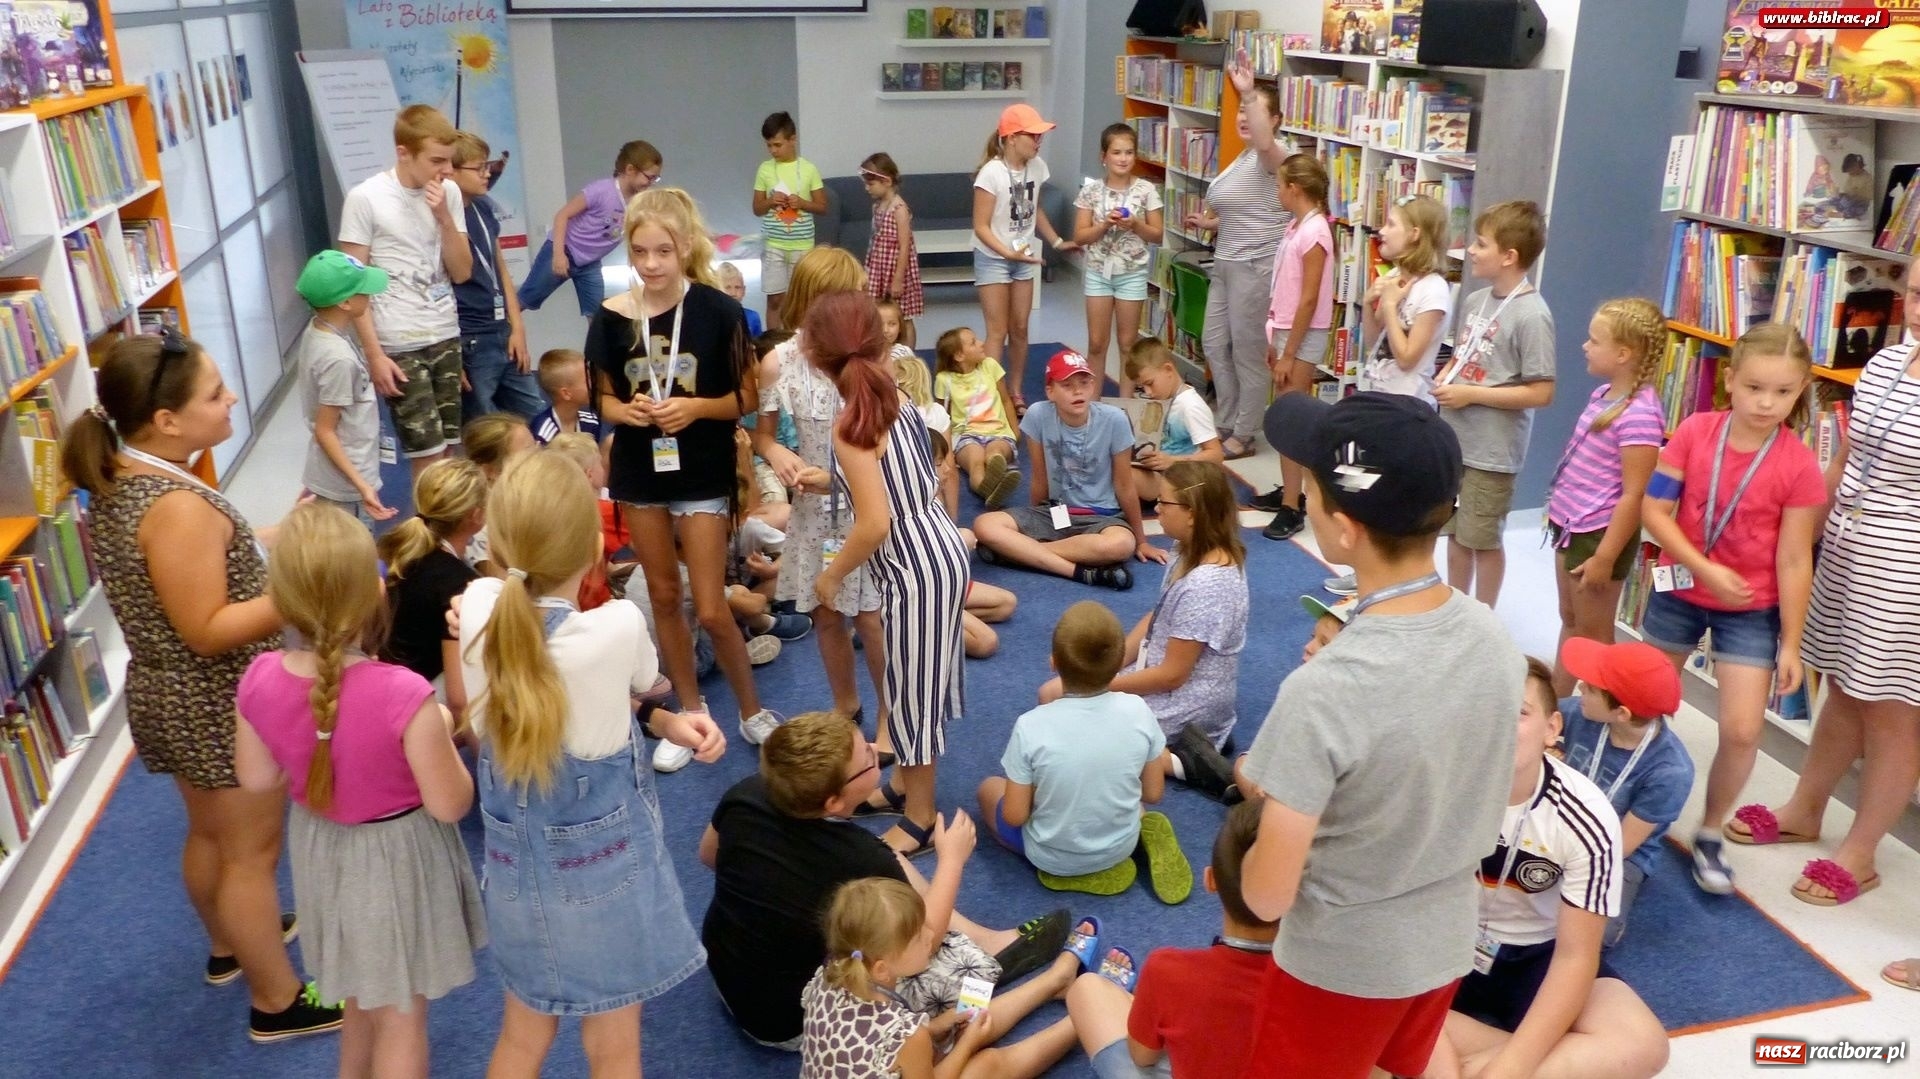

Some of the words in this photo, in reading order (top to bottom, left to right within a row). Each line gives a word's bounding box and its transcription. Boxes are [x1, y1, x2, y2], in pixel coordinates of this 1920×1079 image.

[358, 0, 393, 15] Lato
[399, 2, 497, 28] Biblioteką
[1342, 265, 1351, 302] DINOZAURY
[1820, 426, 1831, 463] MANGA
